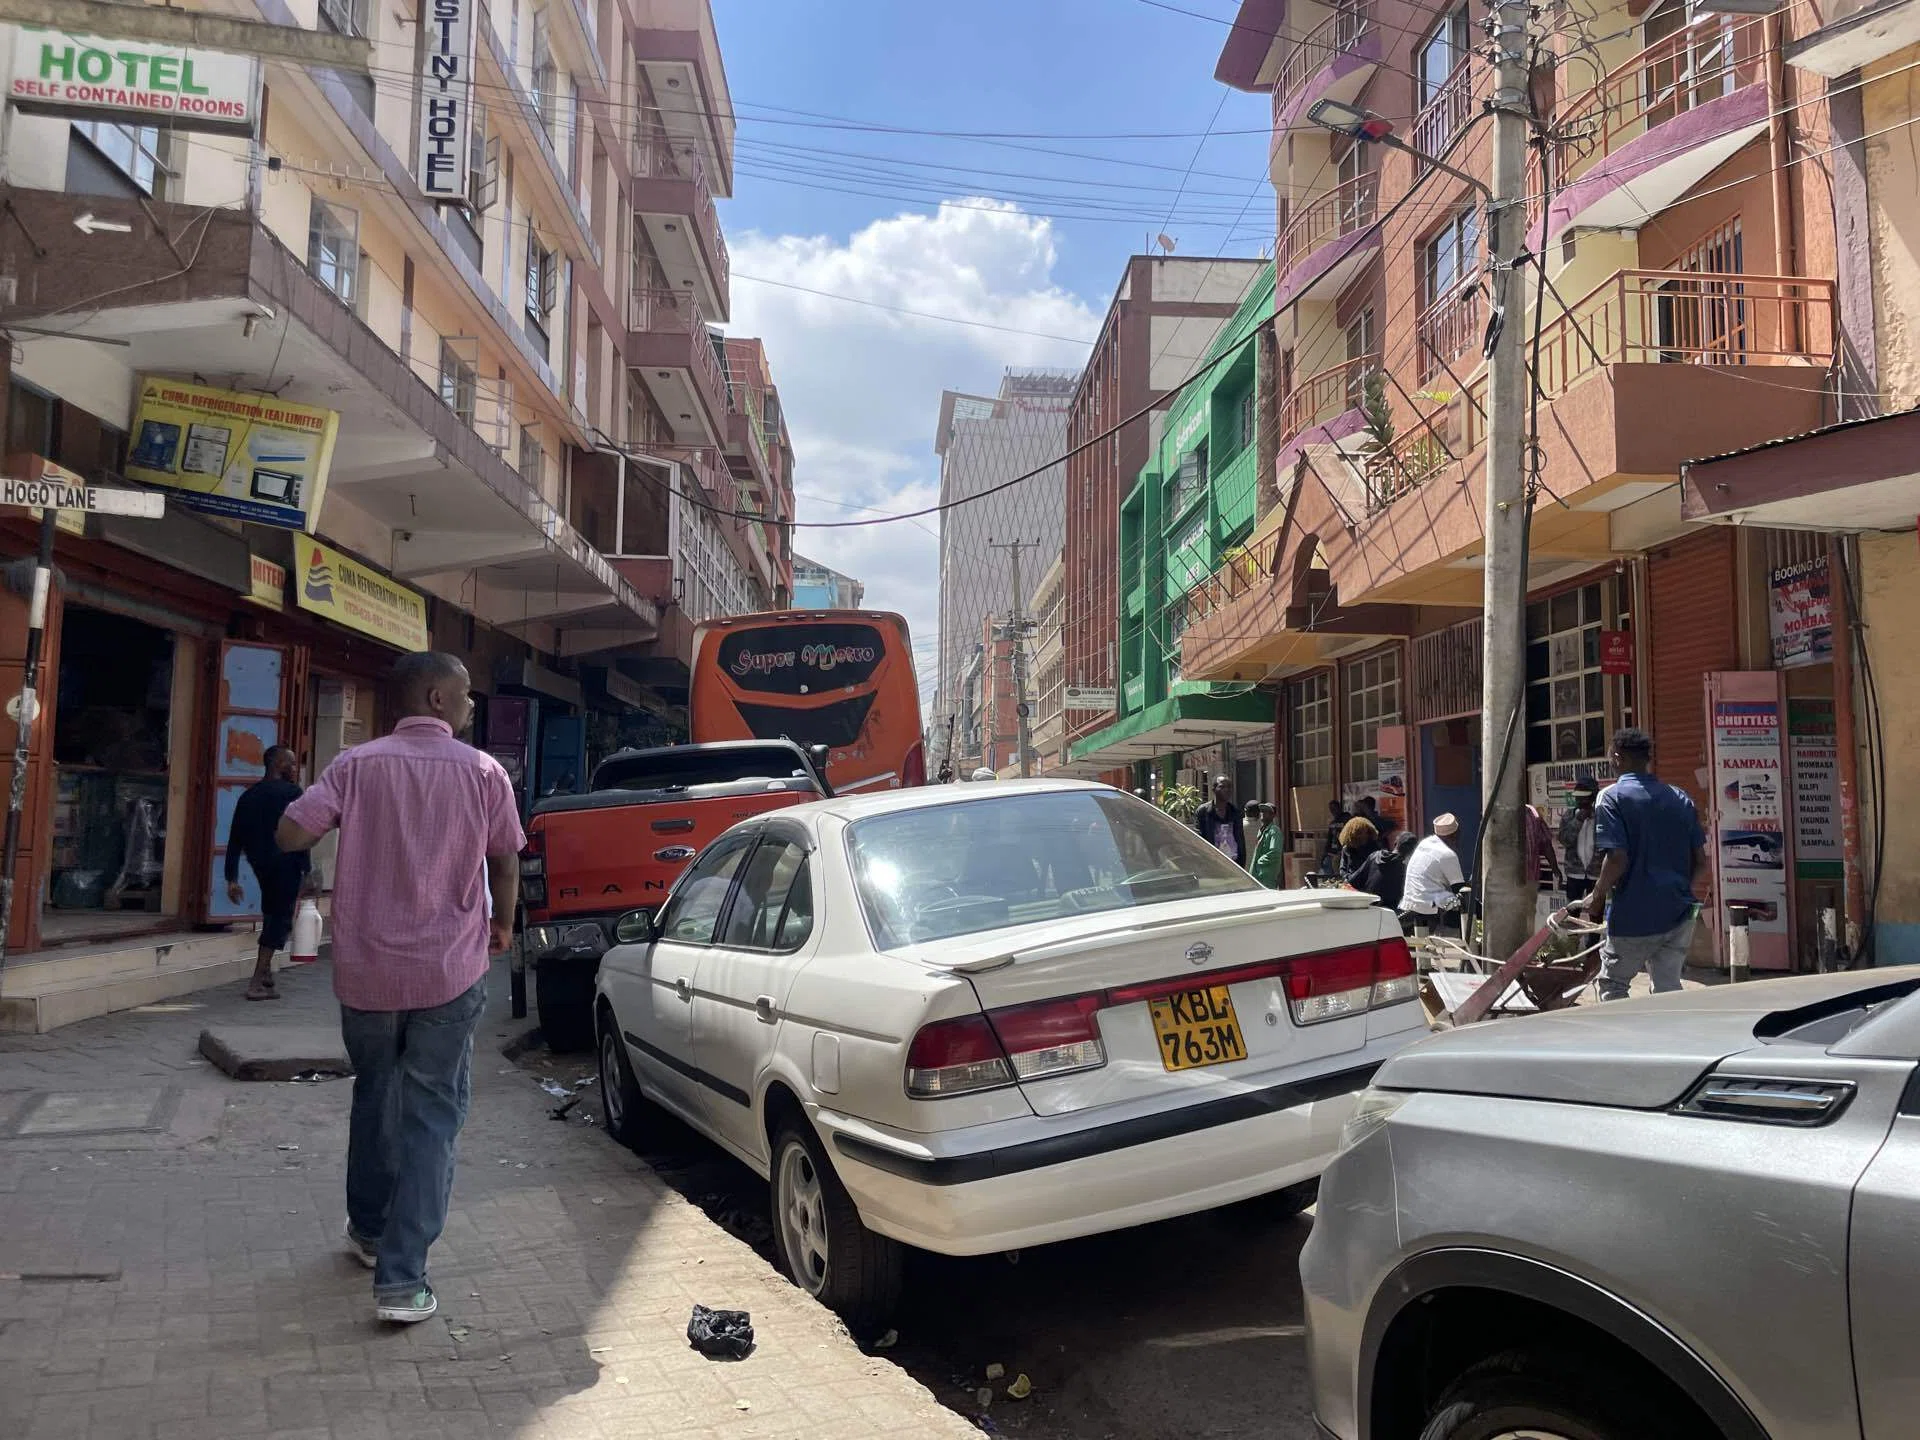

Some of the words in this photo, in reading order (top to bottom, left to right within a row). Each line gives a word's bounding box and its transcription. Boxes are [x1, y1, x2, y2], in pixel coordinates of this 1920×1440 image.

[39, 44, 209, 96] HOTEL
[13, 79, 59, 96] SELF
[65, 86, 174, 110] CONTAINED
[178, 97, 245, 117] ROOMS
[426, 99, 457, 193] HOTEL
[191, 394, 263, 417] REFRIGERATION
[285, 412, 323, 429] LIMITED
[4, 481, 50, 505] HOGO
[56, 486, 97, 510] LANE
[1774, 560, 1813, 582] BOOKING
[730, 649, 796, 676] Super
[801, 643, 875, 671] Metro
[1717, 715, 1778, 726] SHUTTLES
[1723, 759, 1779, 769] KAMPALA
[1797, 761, 1834, 769] MOMBASA
[1800, 805, 1830, 813] MALINDI
[1801, 816, 1830, 824] UKUNDA
[1801, 839, 1836, 847] KAMPALA
[559, 879, 665, 899] RAN
[1168, 986, 1229, 1026] KBL
[1162, 1024, 1240, 1067] 763M
